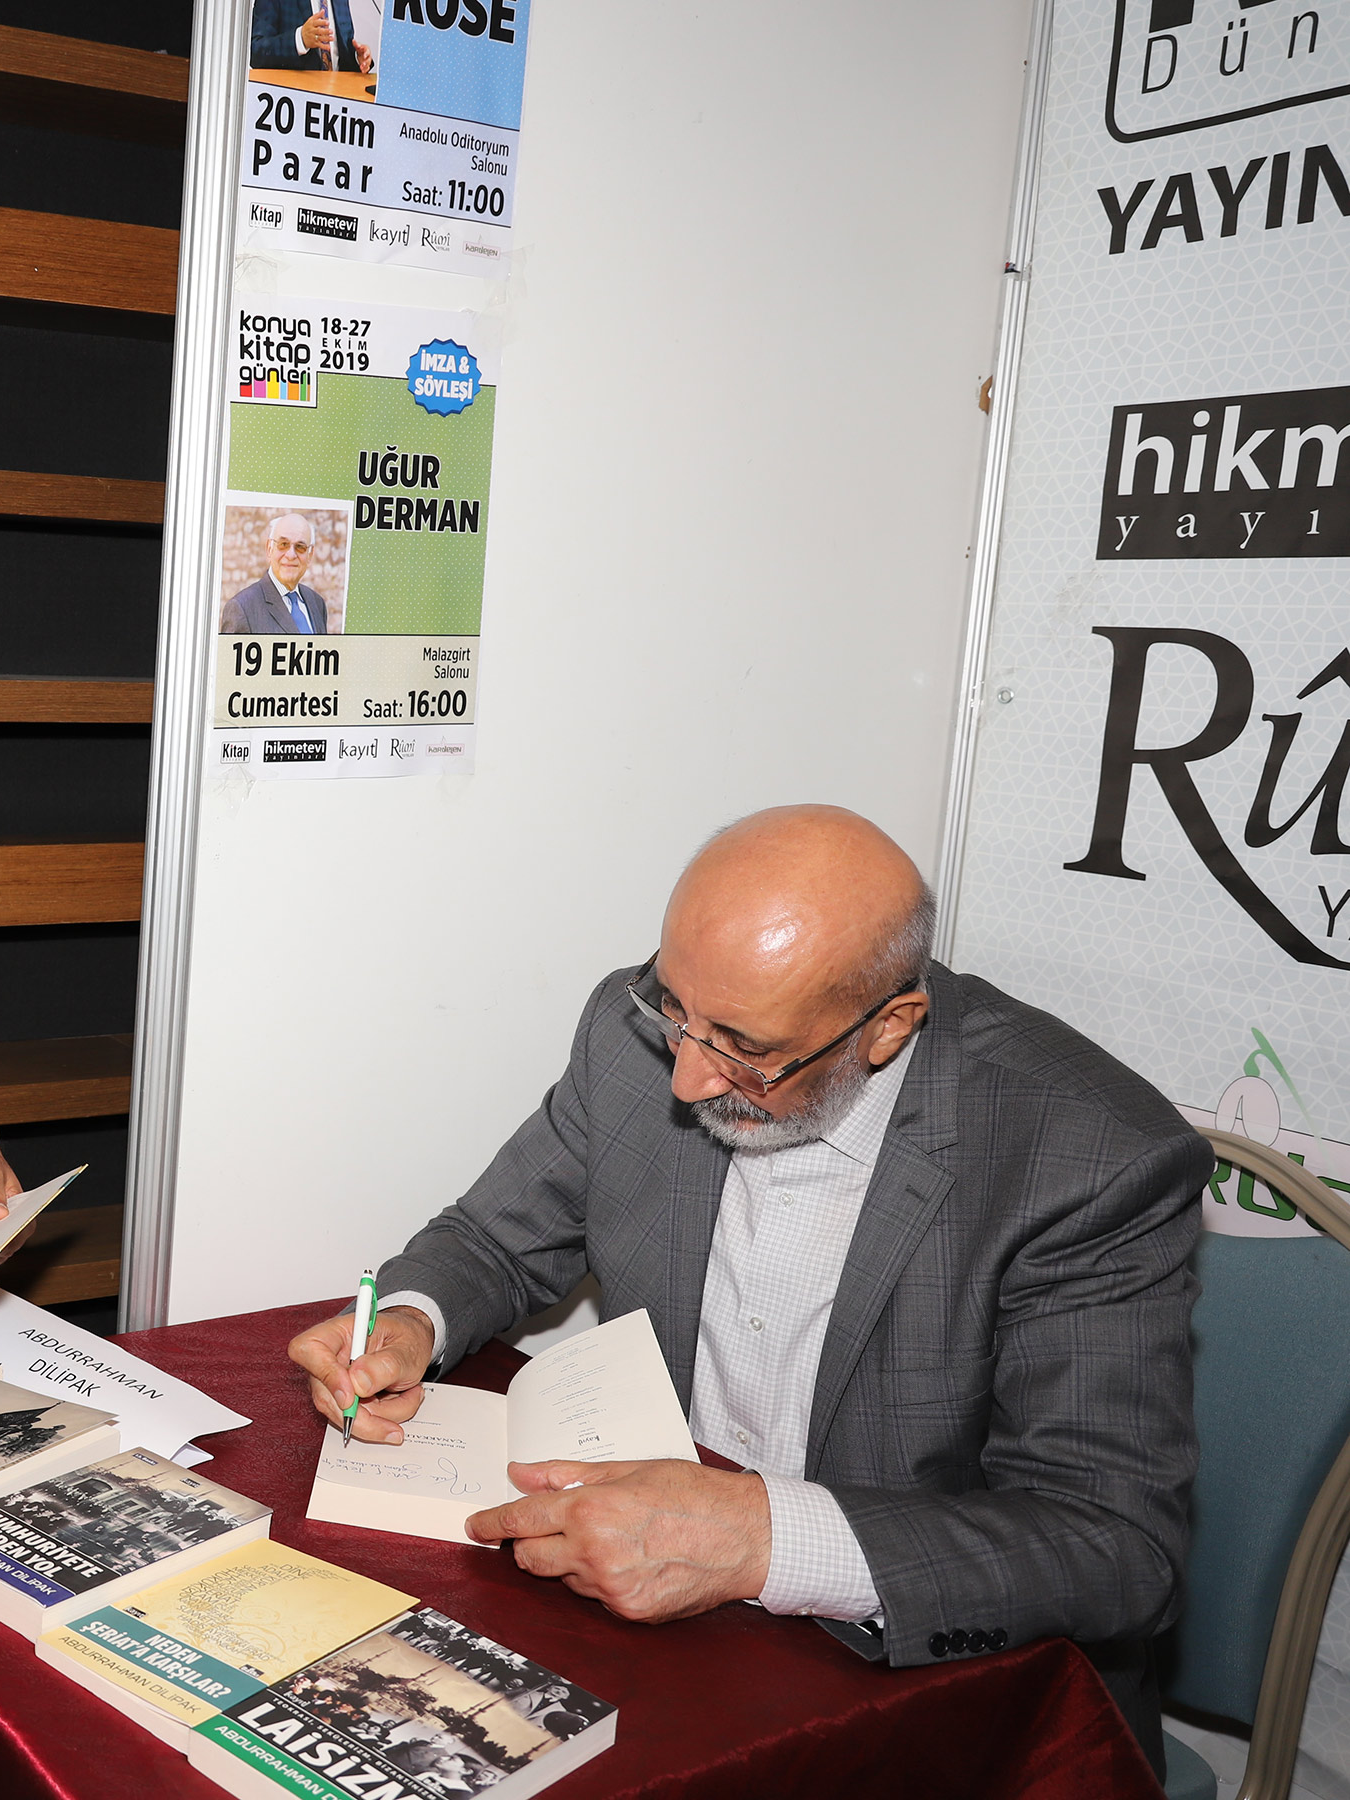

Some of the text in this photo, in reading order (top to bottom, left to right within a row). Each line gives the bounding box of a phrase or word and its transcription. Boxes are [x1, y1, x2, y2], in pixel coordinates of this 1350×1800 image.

[255, 92, 376, 149] 20 Ekim
[400, 122, 510, 158] Anadolu Oditoryum
[252, 139, 373, 194] Pazar
[470, 156, 508, 177] Salonu
[401, 180, 505, 217] Saat: 11:00
[250, 204, 282, 224] Kitap
[299, 208, 357, 233] hikmetevi
[239, 310, 311, 341] konya
[320, 317, 372, 338] 18-27
[239, 334, 311, 367] kitap
[319, 350, 370, 371] 2019
[419, 349, 470, 374] İMZA &
[239, 363, 311, 386] günleri
[414, 376, 474, 402] SÖYLEŞİ
[358, 445, 440, 488] UĞUR
[355, 495, 480, 533] DERMAN
[232, 642, 340, 676] 19 Ekim
[422, 646, 471, 663] Malazgirt
[434, 665, 470, 679] Salonu
[227, 690, 339, 718] Cumartesi
[363, 690, 467, 718] Saat: 16:00
[223, 743, 249, 763] Kitap
[265, 741, 326, 755] hikmetevi
[18, 1329, 163, 1400] ABDURRAHMAN
[28, 1358, 101, 1397] DİLİPAK
[24, 1553, 63, 1578] YOL
[58, 1636, 153, 1687] ABDURRAHMAN
[144, 1634, 202, 1665] NEDEN
[142, 1652, 232, 1699] KARŞILAR?
[214, 1725, 325, 1796] ABDURRAHMAN
